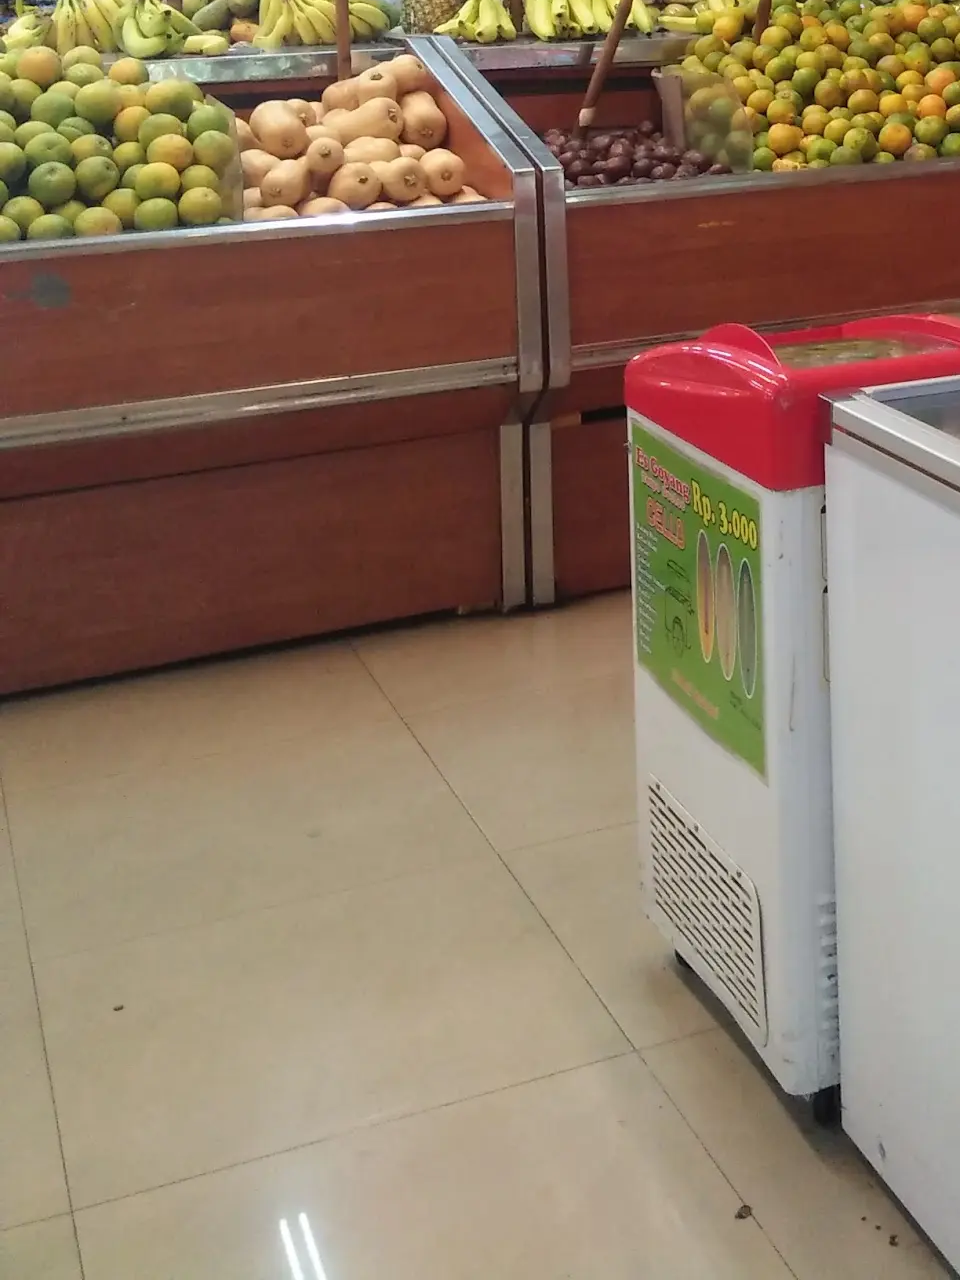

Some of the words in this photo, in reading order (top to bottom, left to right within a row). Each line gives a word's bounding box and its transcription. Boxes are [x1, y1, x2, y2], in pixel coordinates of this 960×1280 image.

[635, 445, 649, 471] Es
[649, 455, 690, 505] Goyang
[691, 478, 716, 528] Rp.
[718, 501, 758, 550] 3.000
